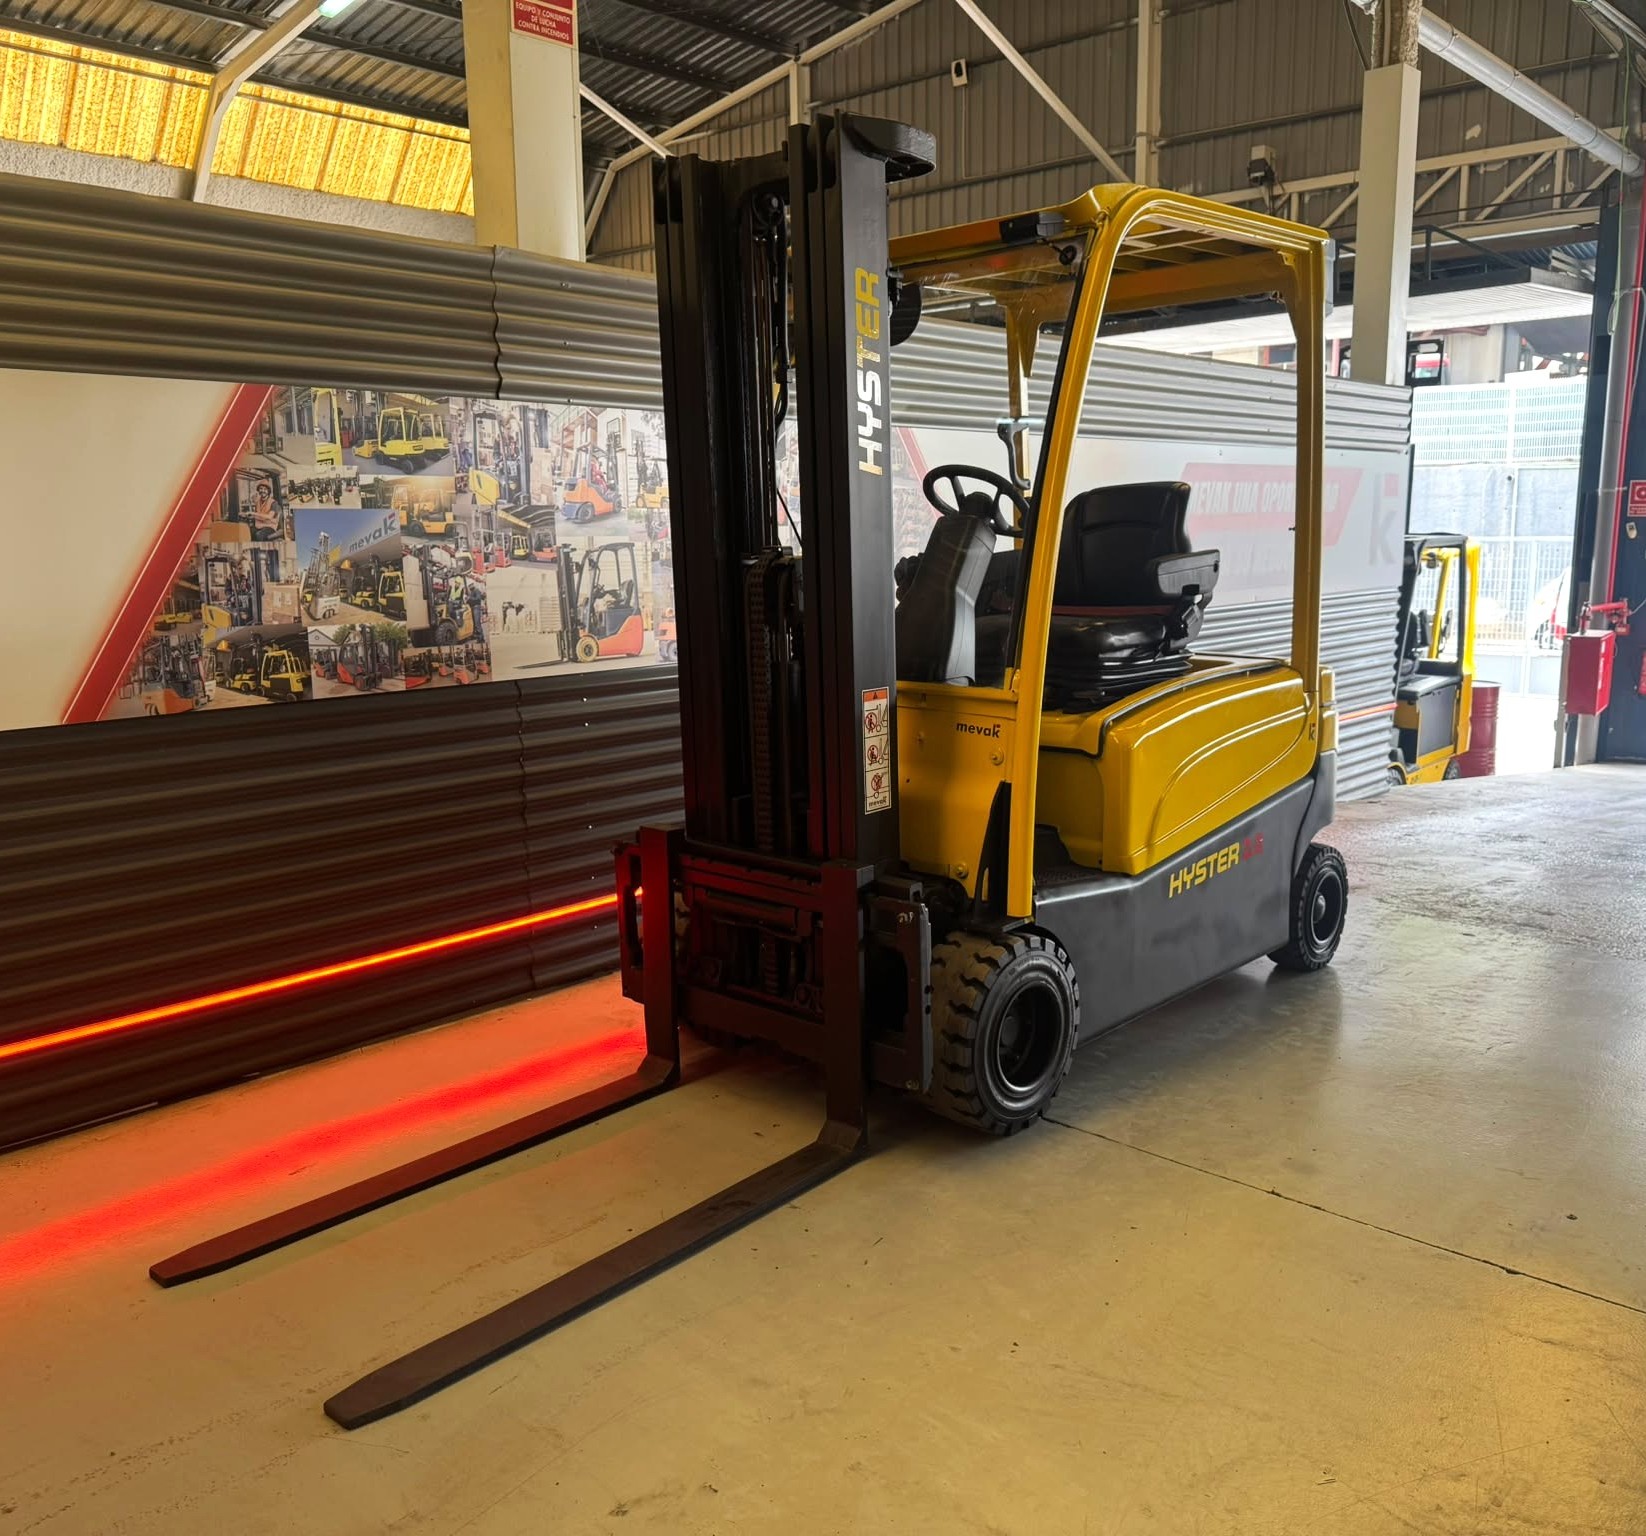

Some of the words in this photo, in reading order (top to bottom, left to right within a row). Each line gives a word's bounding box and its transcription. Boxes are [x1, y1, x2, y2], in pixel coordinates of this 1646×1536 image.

[515, 1, 536, 14] EQUIPO
[542, 9, 571, 25] CONJUNTO
[530, 14, 538, 23] DE
[539, 16, 557, 29] LUCHA
[518, 19, 541, 32] CONTRA
[541, 26, 570, 41] INCENDIOS
[855, 267, 883, 476] HYSTER
[349, 512, 397, 553] mevak
[955, 721, 1002, 739] mevak
[868, 796, 888, 808] mevak
[1168, 841, 1241, 899] HYSTER
